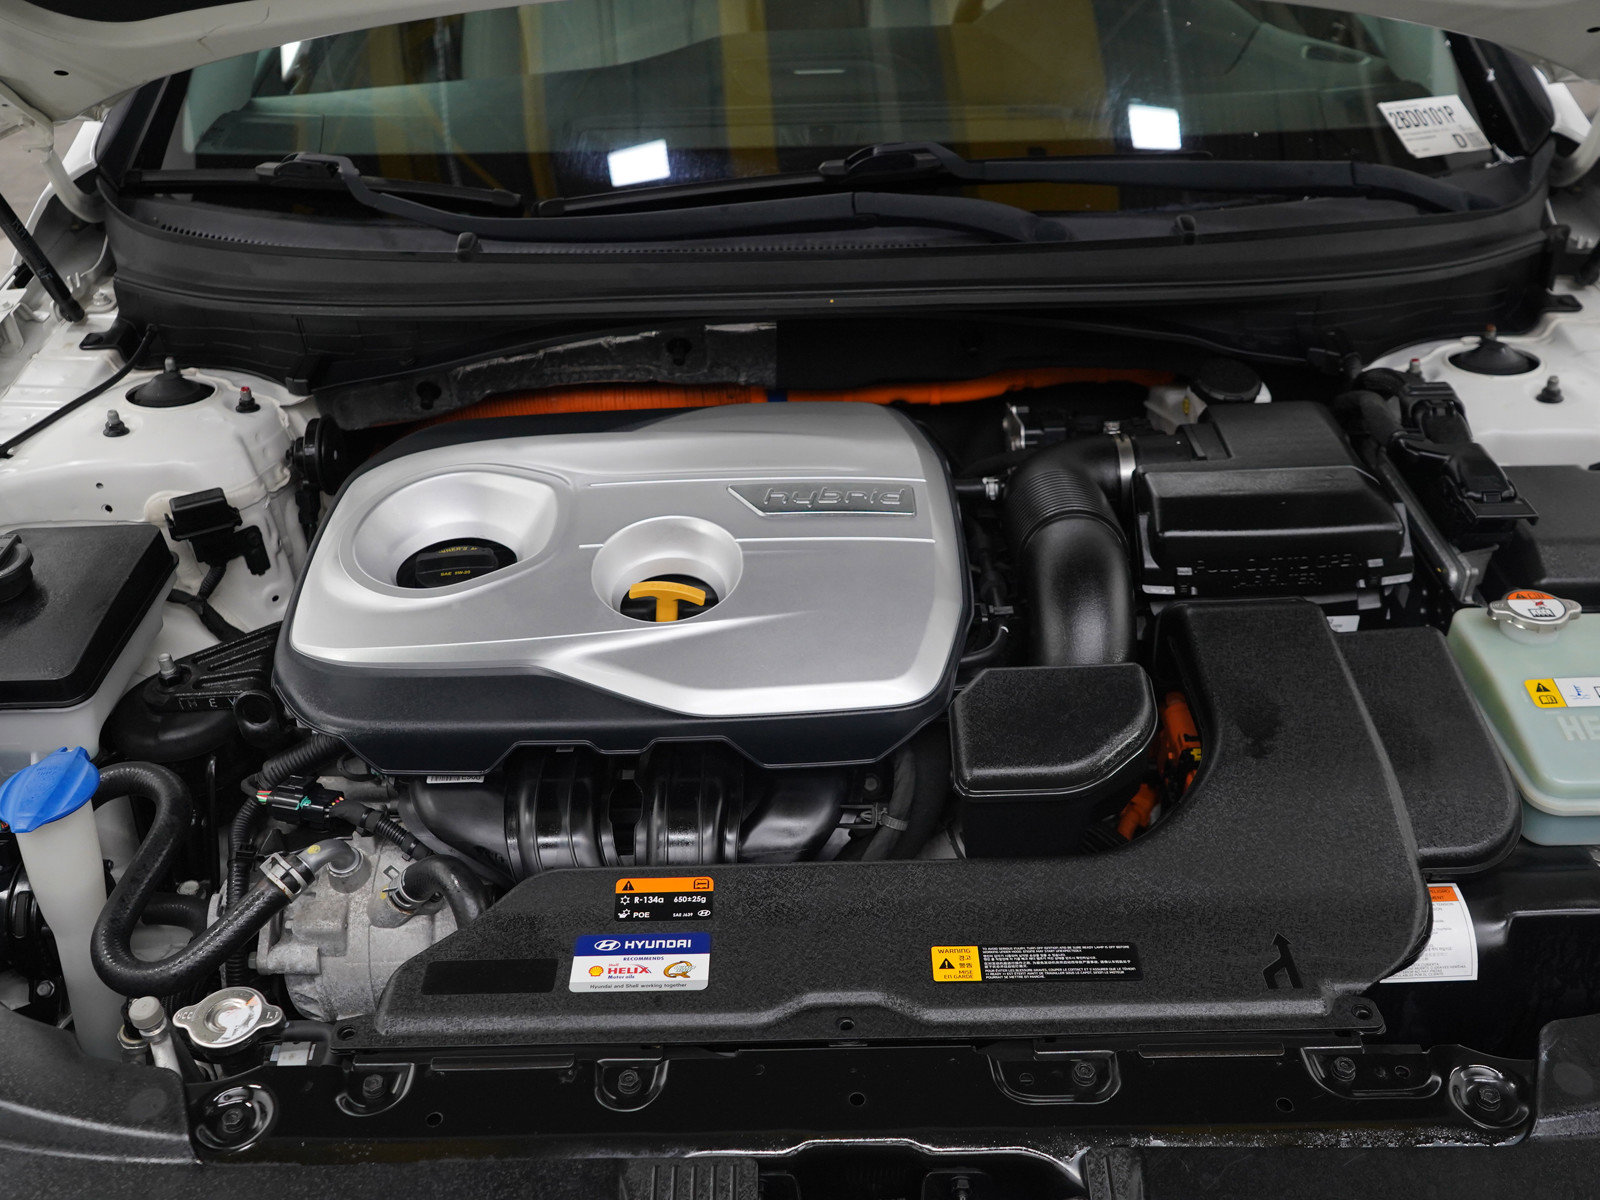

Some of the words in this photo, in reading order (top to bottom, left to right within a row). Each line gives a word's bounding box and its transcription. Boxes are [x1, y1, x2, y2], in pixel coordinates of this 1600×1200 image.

[1452, 133, 1468, 148] D
[764, 486, 904, 508] hybrid
[634, 896, 665, 904] R-134a
[673, 896, 707, 904] 650±25g
[624, 939, 692, 949] HYUNDAI
[608, 964, 652, 975] HELIX
